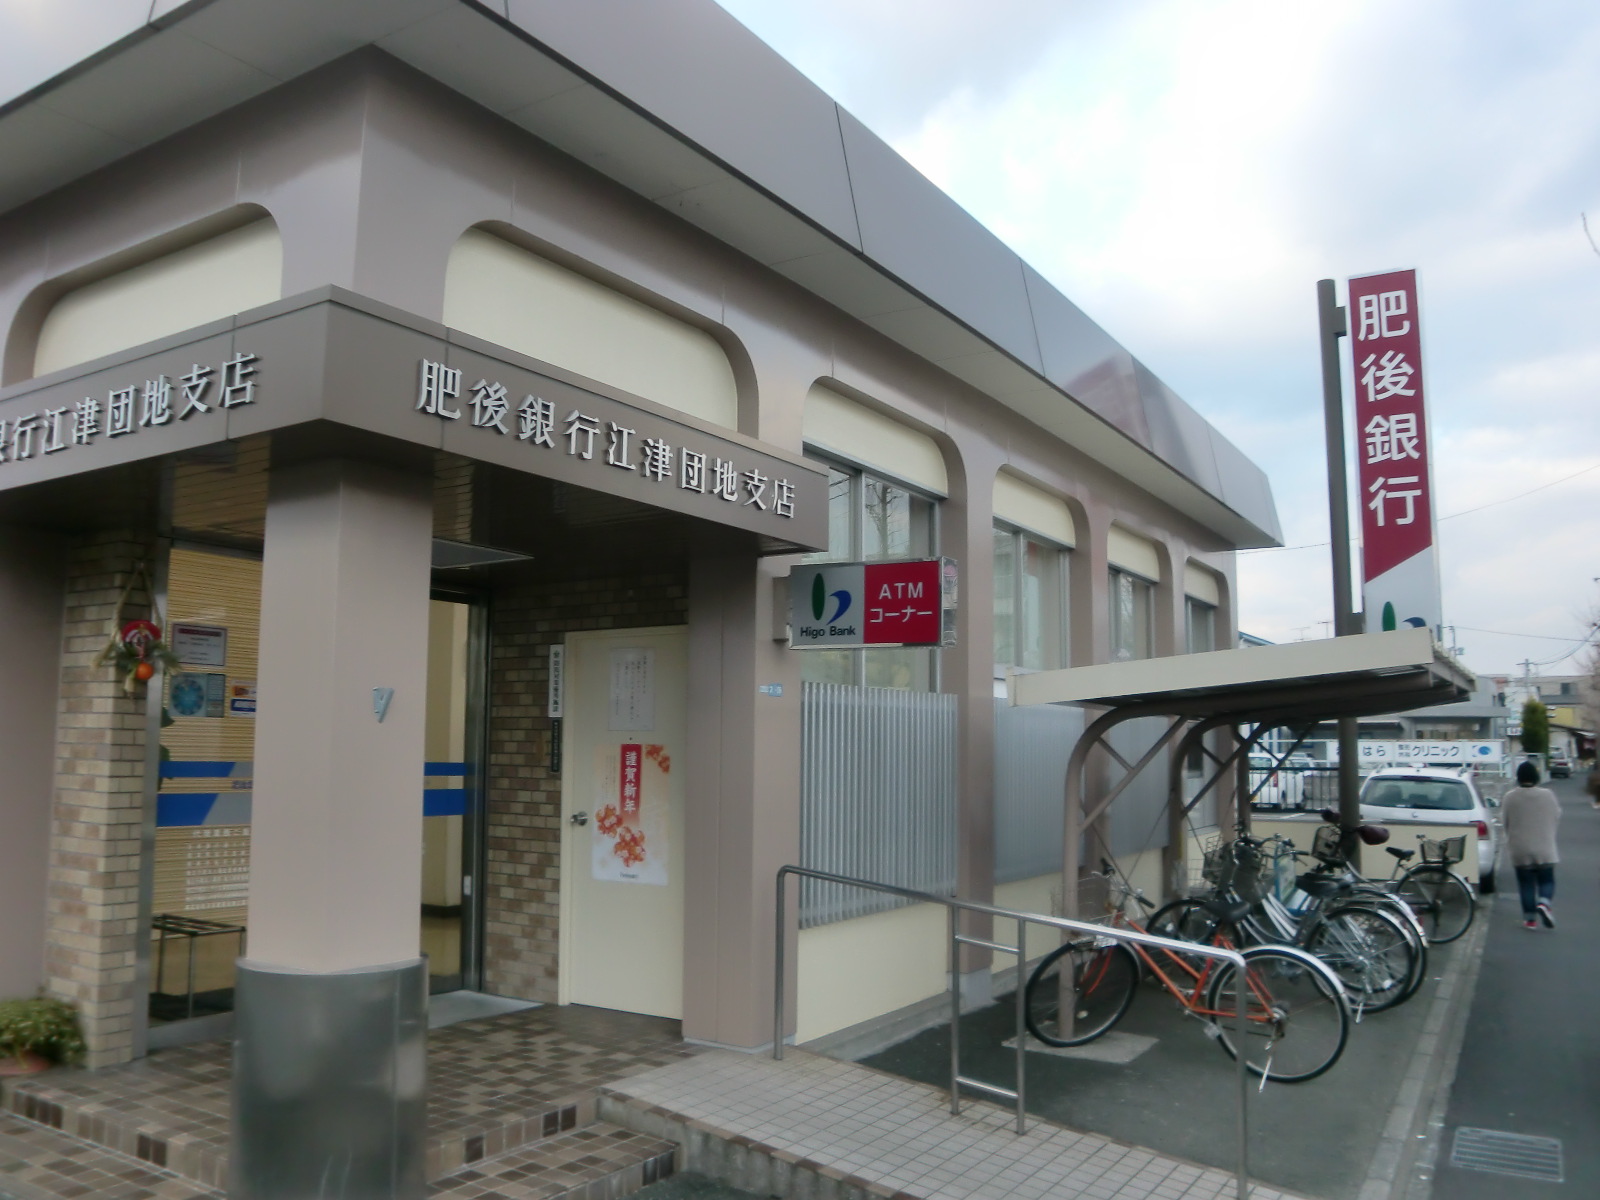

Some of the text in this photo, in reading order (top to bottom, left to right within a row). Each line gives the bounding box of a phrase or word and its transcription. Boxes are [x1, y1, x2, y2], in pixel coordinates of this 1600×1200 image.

[1358, 289, 1422, 527] 肥後銀行
[416, 358, 795, 518] 肥後銀行江津団地支店
[878, 582, 924, 600] ATM
[869, 605, 933, 623] コーナー
[800, 625, 856, 639] Higo Bank
[1412, 745, 1460, 757] クリニック
[624, 750, 638, 814] 謹賀新年
